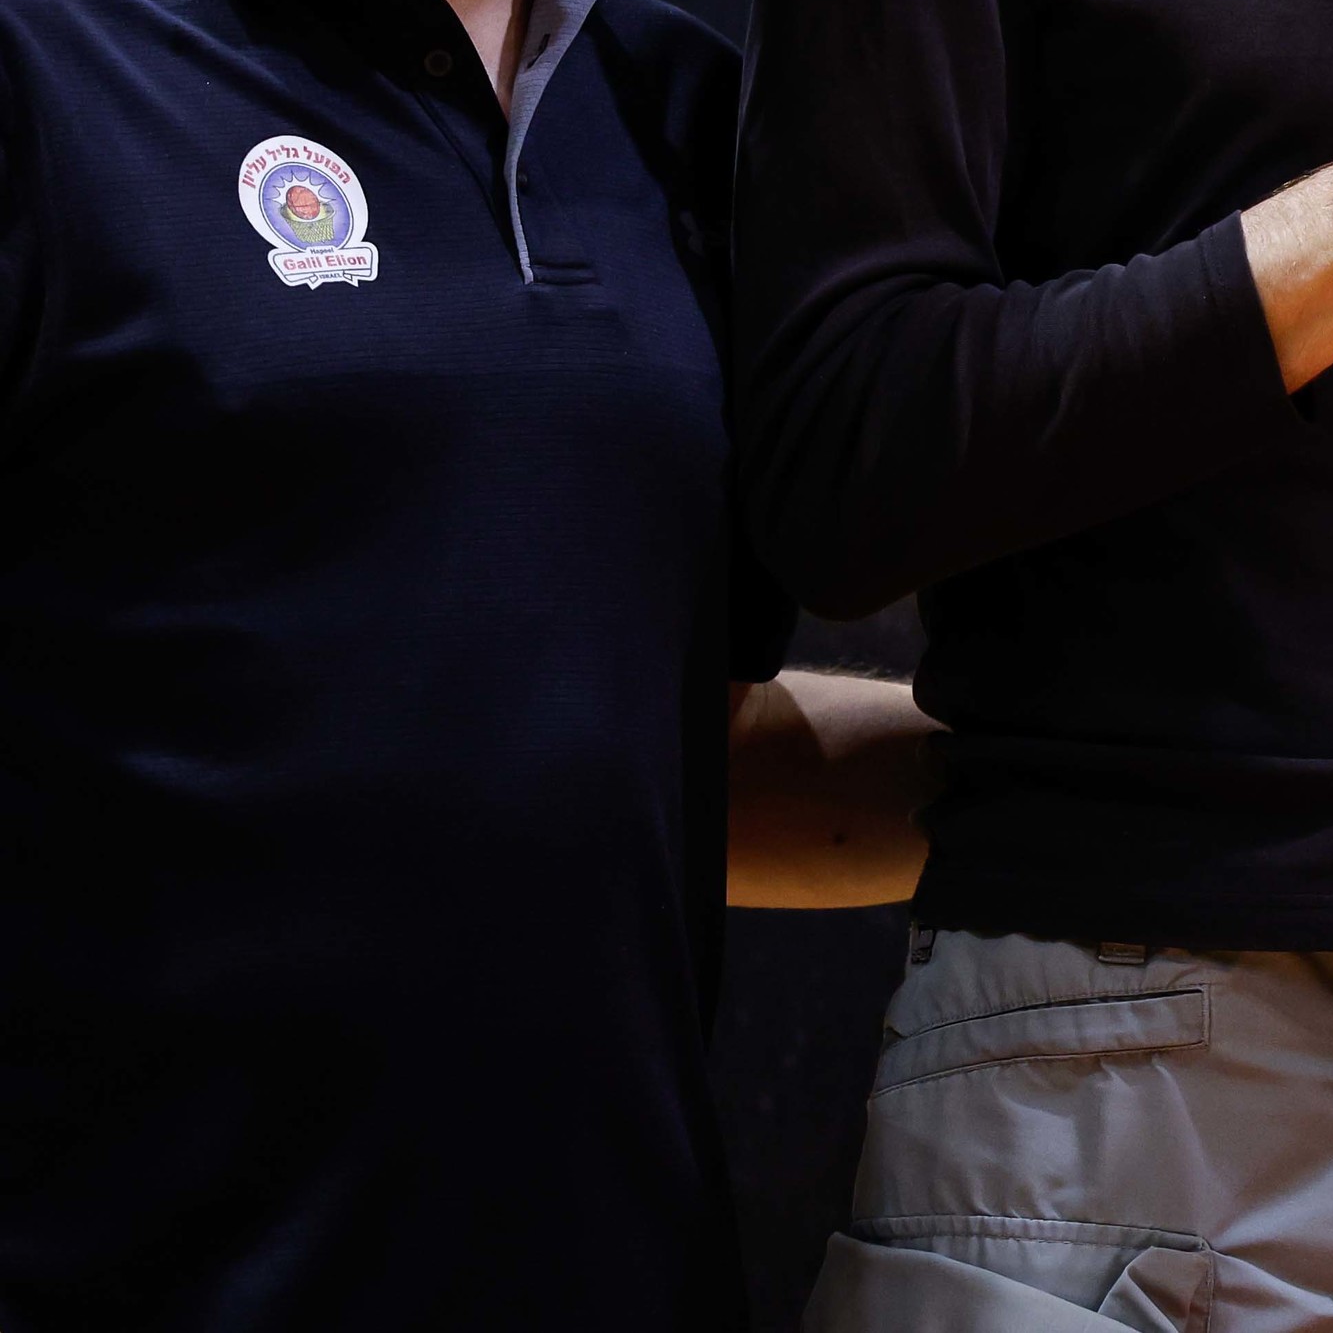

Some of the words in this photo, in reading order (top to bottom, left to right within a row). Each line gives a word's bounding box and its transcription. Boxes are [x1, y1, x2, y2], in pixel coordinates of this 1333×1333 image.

[265, 144, 300, 161] גליל
[303, 145, 351, 184] הפועל
[241, 156, 267, 189] עליון
[283, 256, 323, 271] Galil
[325, 254, 367, 267] Elion
